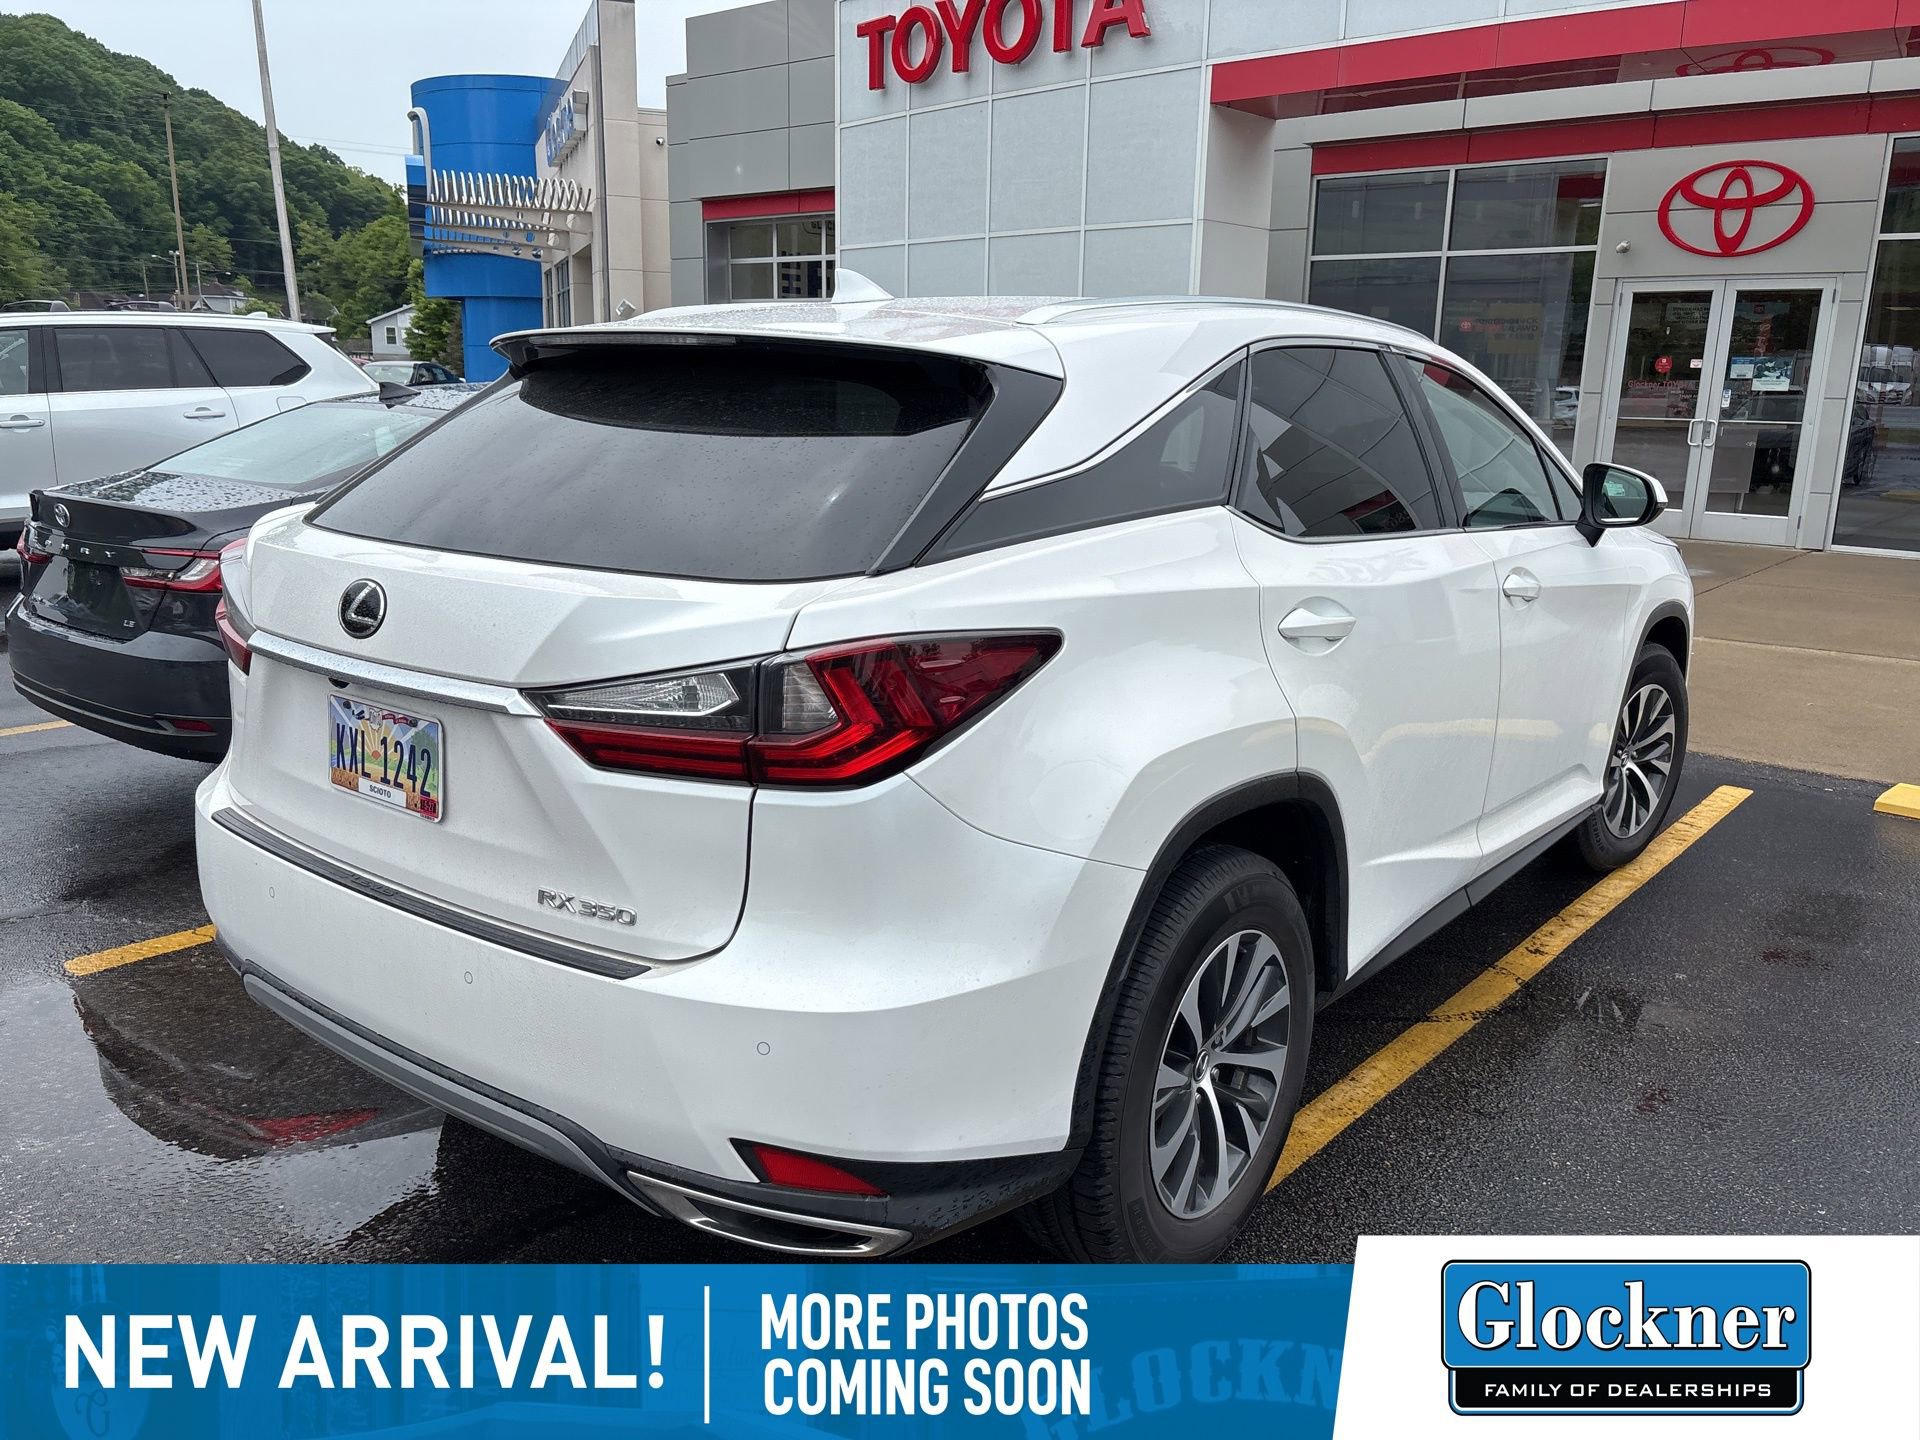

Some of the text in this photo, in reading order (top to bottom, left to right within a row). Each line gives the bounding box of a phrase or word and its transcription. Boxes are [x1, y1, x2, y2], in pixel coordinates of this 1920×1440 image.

[856, 0, 1151, 91] TOYOTA
[336, 722, 431, 798] KXL 1242
[369, 784, 392, 798] SCIOTO
[537, 888, 638, 927] RX 350
